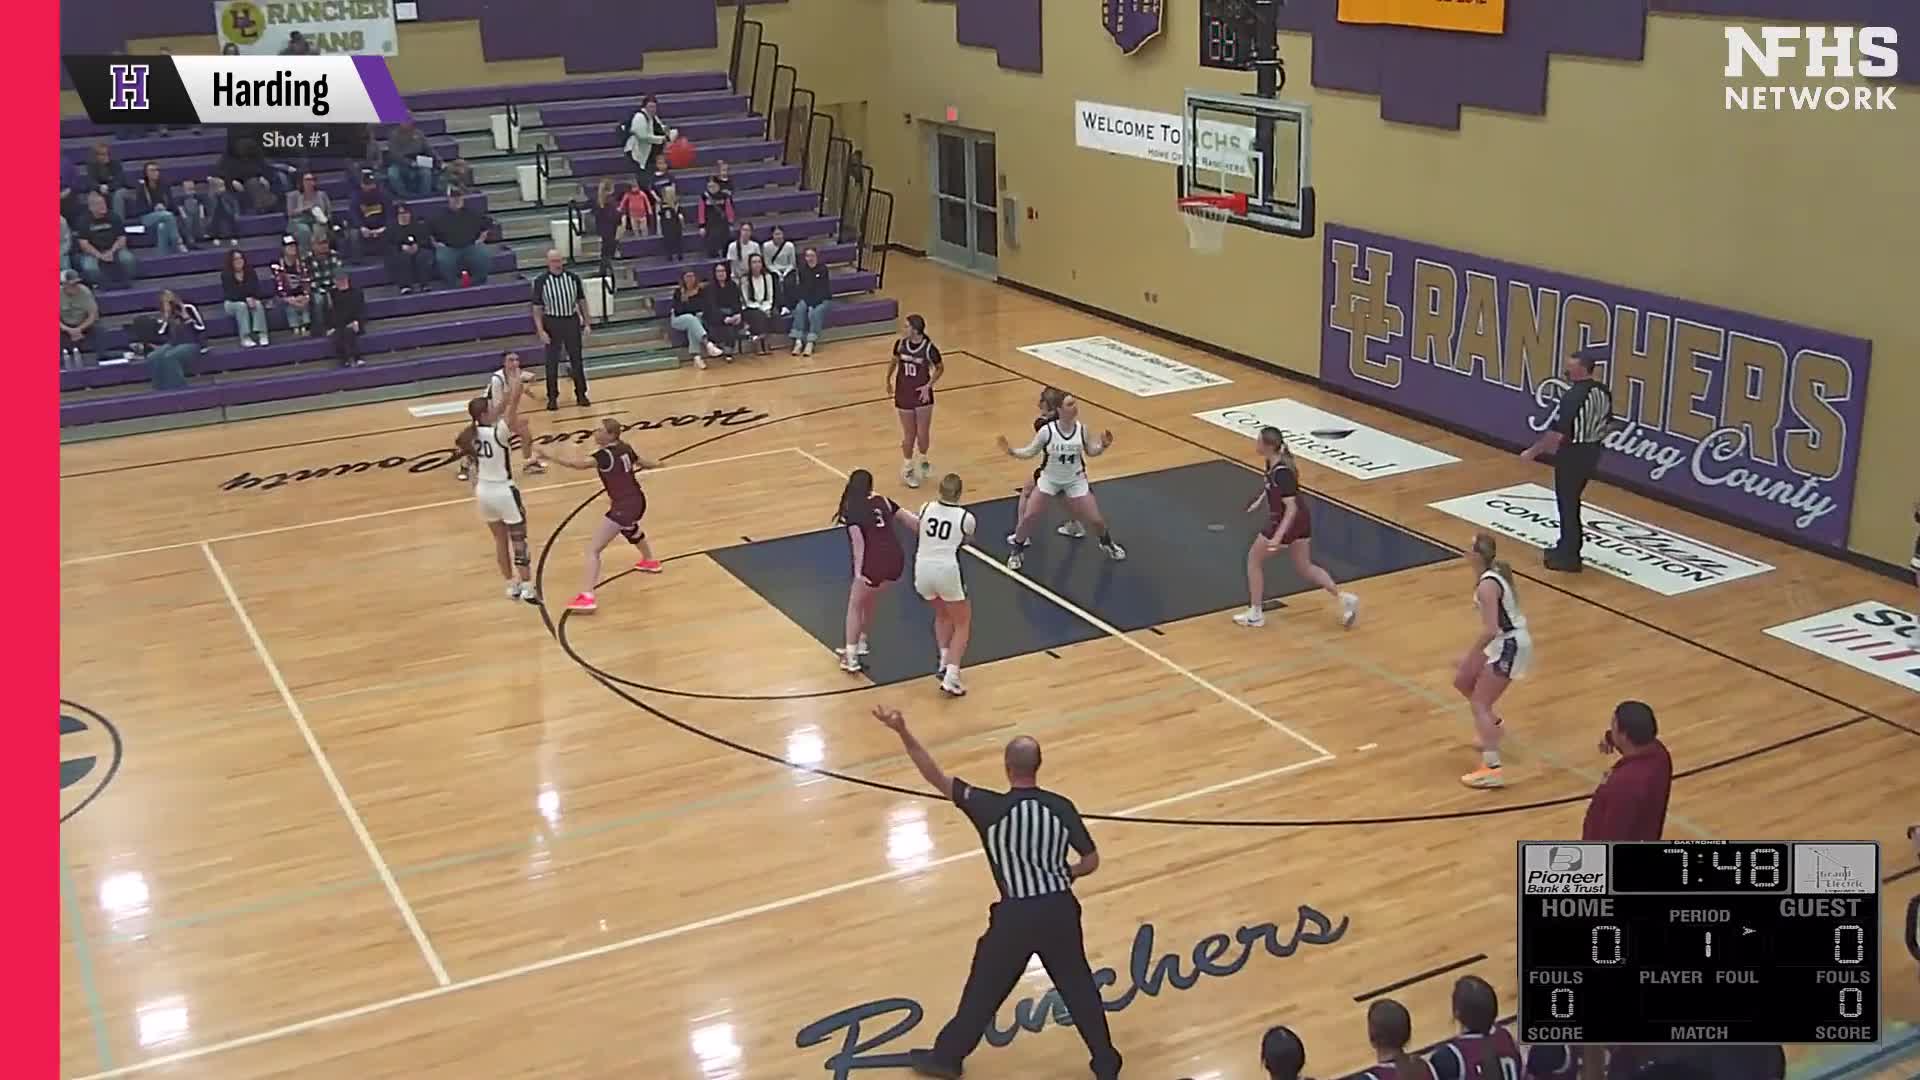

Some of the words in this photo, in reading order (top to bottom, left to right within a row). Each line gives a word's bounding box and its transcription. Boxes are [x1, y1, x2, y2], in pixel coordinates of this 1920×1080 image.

[267, 0, 389, 24] RANCHER
[1082, 110, 1154, 140] WELCOME
[1160, 124, 1181, 144] TO
[903, 362, 917, 377] 10
[474, 439, 493, 458] 20
[1058, 453, 1075, 465] 44
[1692, 427, 1836, 528] County
[926, 517, 952, 540] 30
